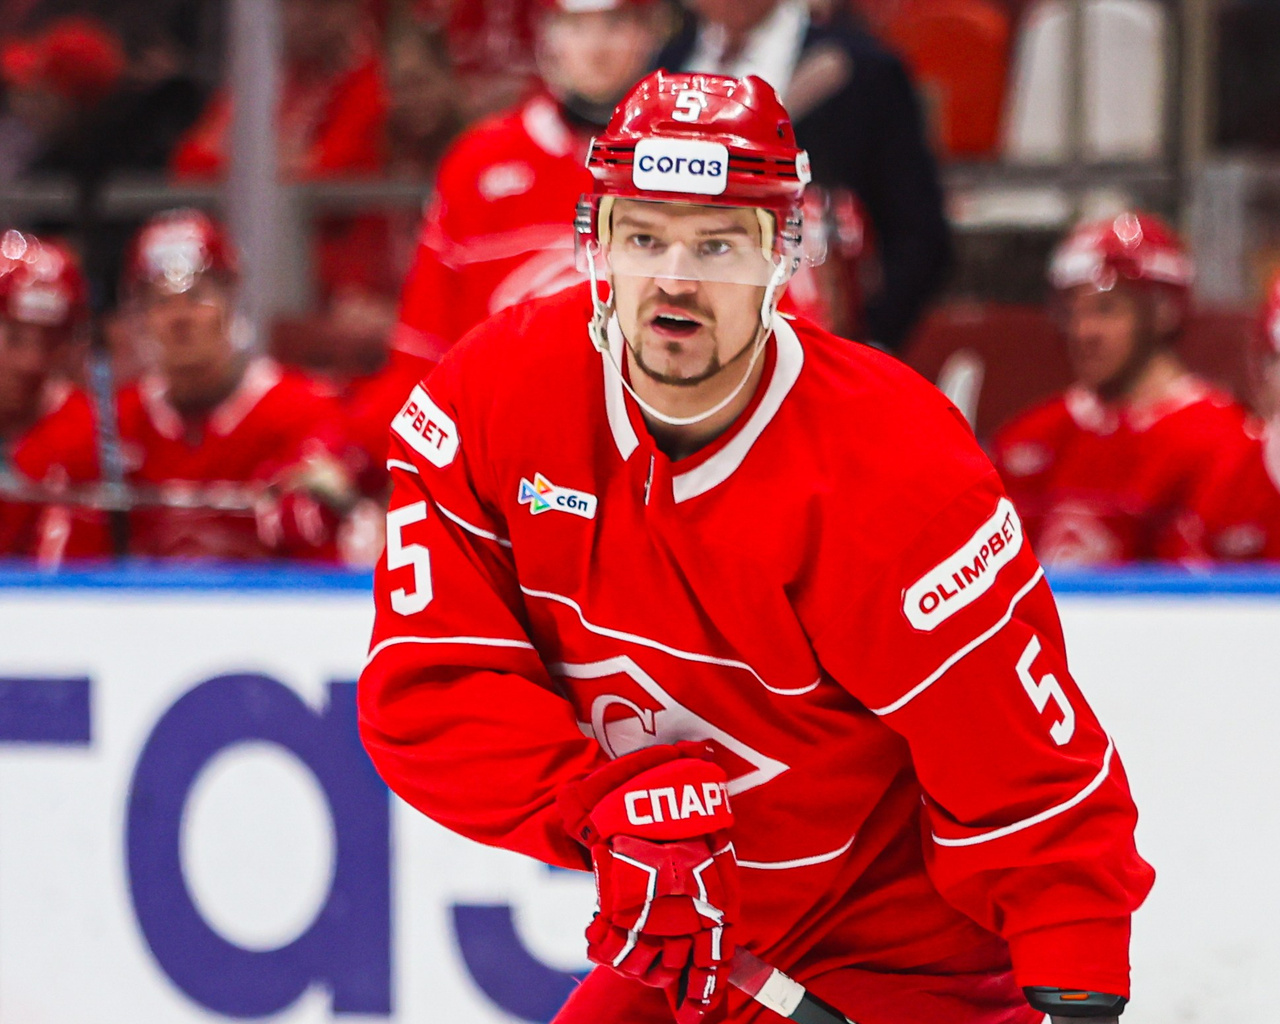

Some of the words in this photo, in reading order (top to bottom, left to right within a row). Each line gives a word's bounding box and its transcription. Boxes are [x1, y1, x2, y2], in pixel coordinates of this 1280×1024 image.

[672, 89, 706, 122] 5
[556, 494, 589, 512] сбп
[386, 500, 434, 616] 5
[919, 512, 1015, 614] OLIMPBET
[1015, 633, 1075, 746] 5
